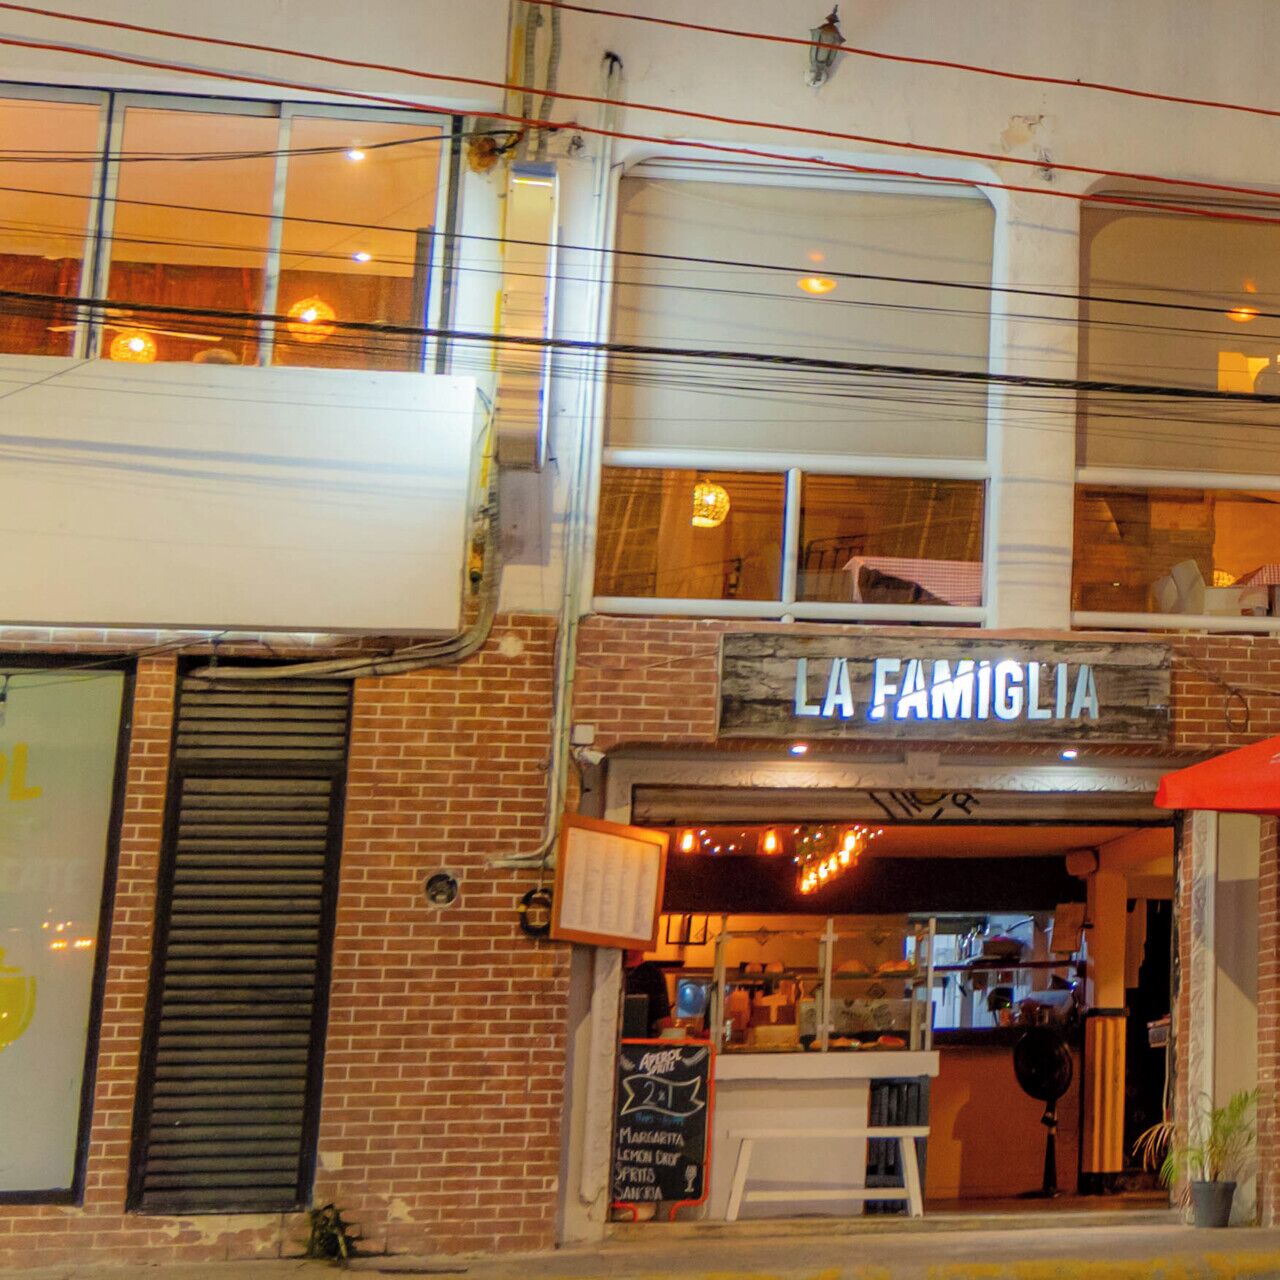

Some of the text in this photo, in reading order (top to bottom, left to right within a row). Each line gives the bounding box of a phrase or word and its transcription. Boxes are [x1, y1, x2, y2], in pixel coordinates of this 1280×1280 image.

[795, 657, 1099, 720] LA FAMIGLIA
[0, 742, 42, 801] L
